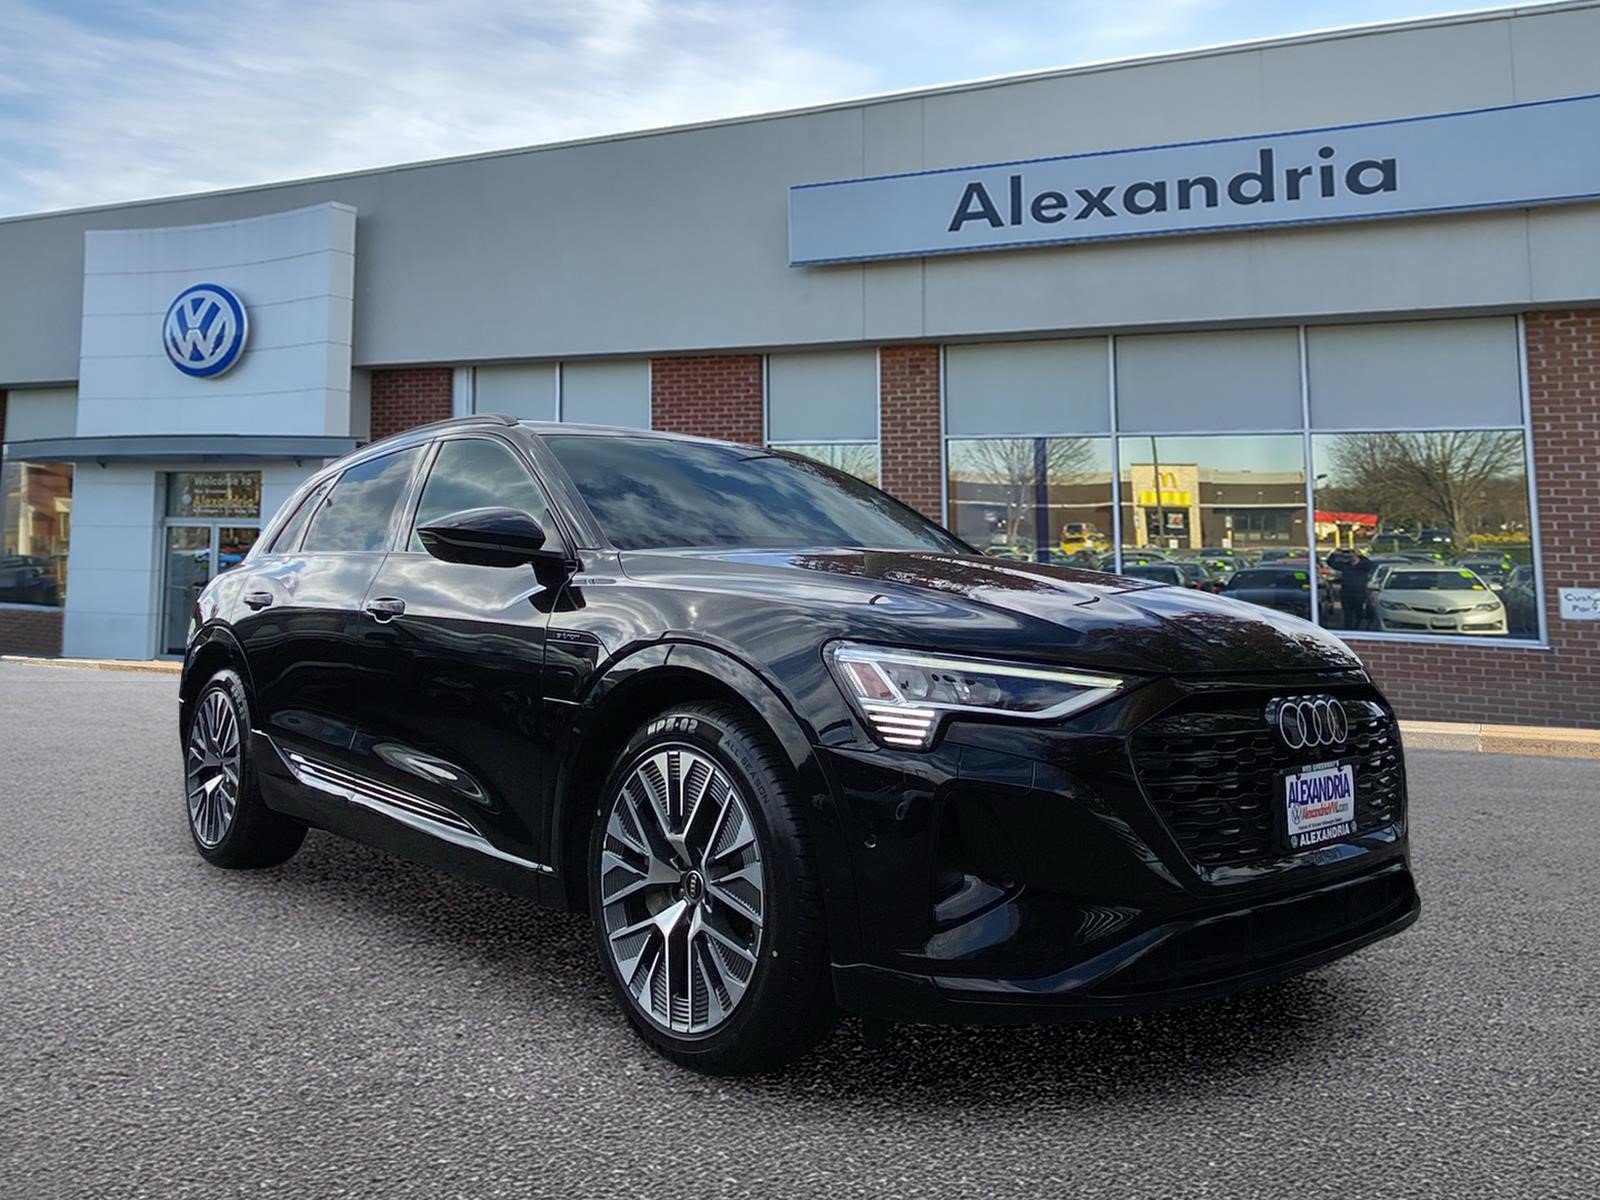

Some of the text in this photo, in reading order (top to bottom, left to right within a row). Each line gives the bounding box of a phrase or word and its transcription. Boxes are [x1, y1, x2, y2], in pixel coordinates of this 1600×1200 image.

[947, 146, 1398, 232] Alexandria
[724, 739, 770, 804] ALL SEASON
[1288, 772, 1351, 808] ALEXANDRIA
[1299, 822, 1351, 847] ALEXANDRIA
